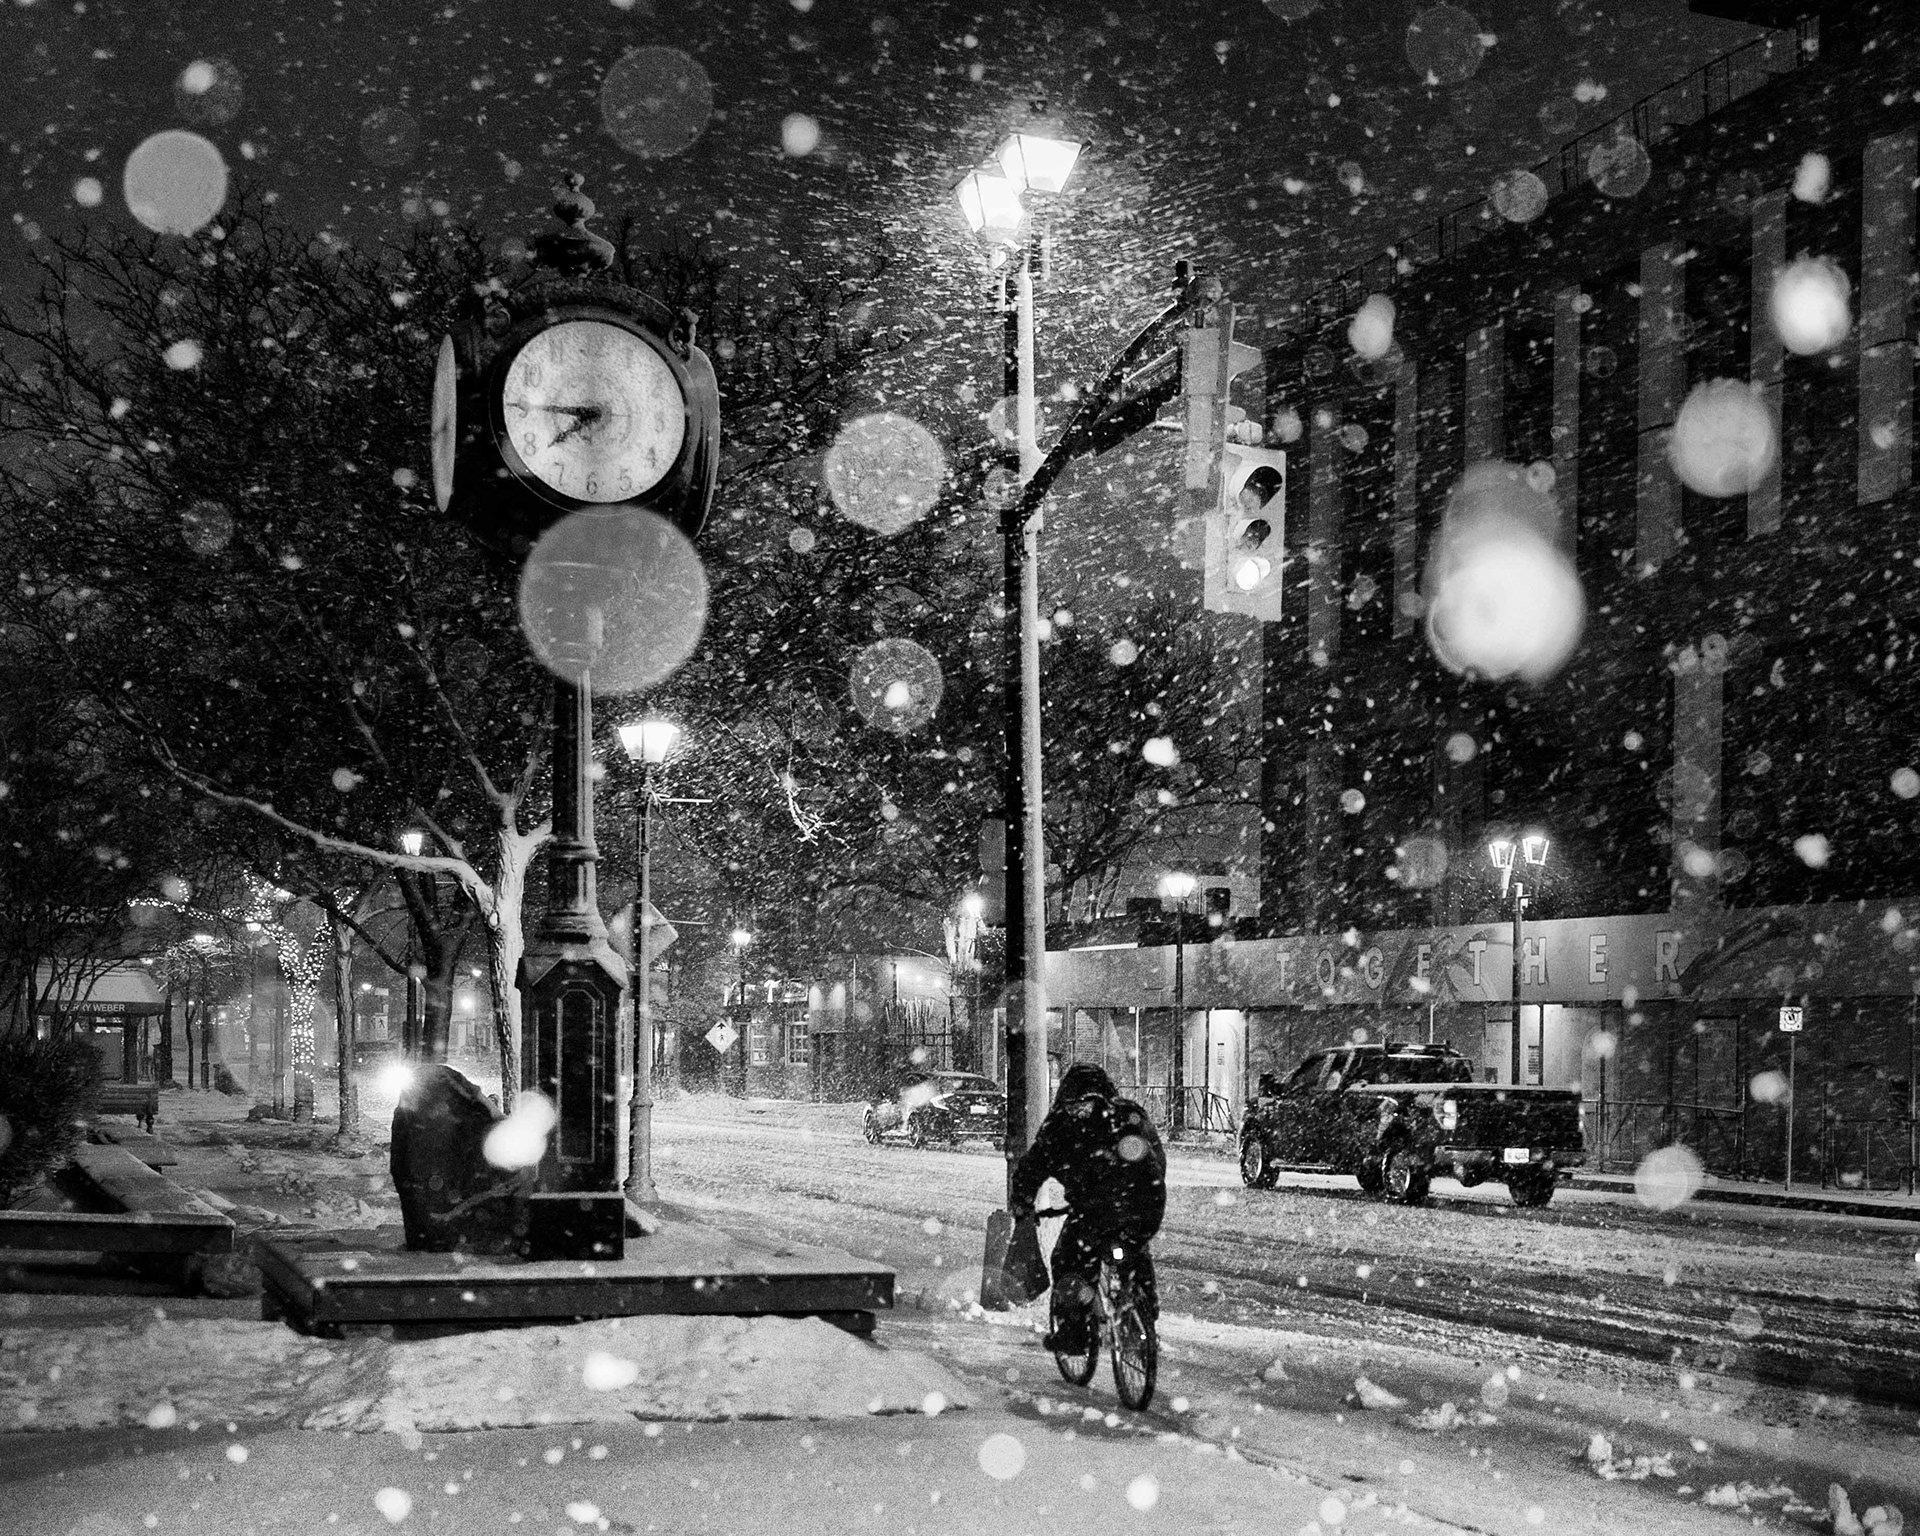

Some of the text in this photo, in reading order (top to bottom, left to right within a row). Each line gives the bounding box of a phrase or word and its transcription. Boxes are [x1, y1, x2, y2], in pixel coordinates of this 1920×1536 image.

[522, 363, 543, 388] 10
[654, 411, 666, 433] 3
[522, 431, 537, 456] 8
[554, 461, 566, 487] 7
[585, 471, 598, 495] 6
[618, 468, 632, 492] 5
[1276, 930, 1679, 991] TOGETHER
[60, 1003, 126, 1012] GRRY WEBER
